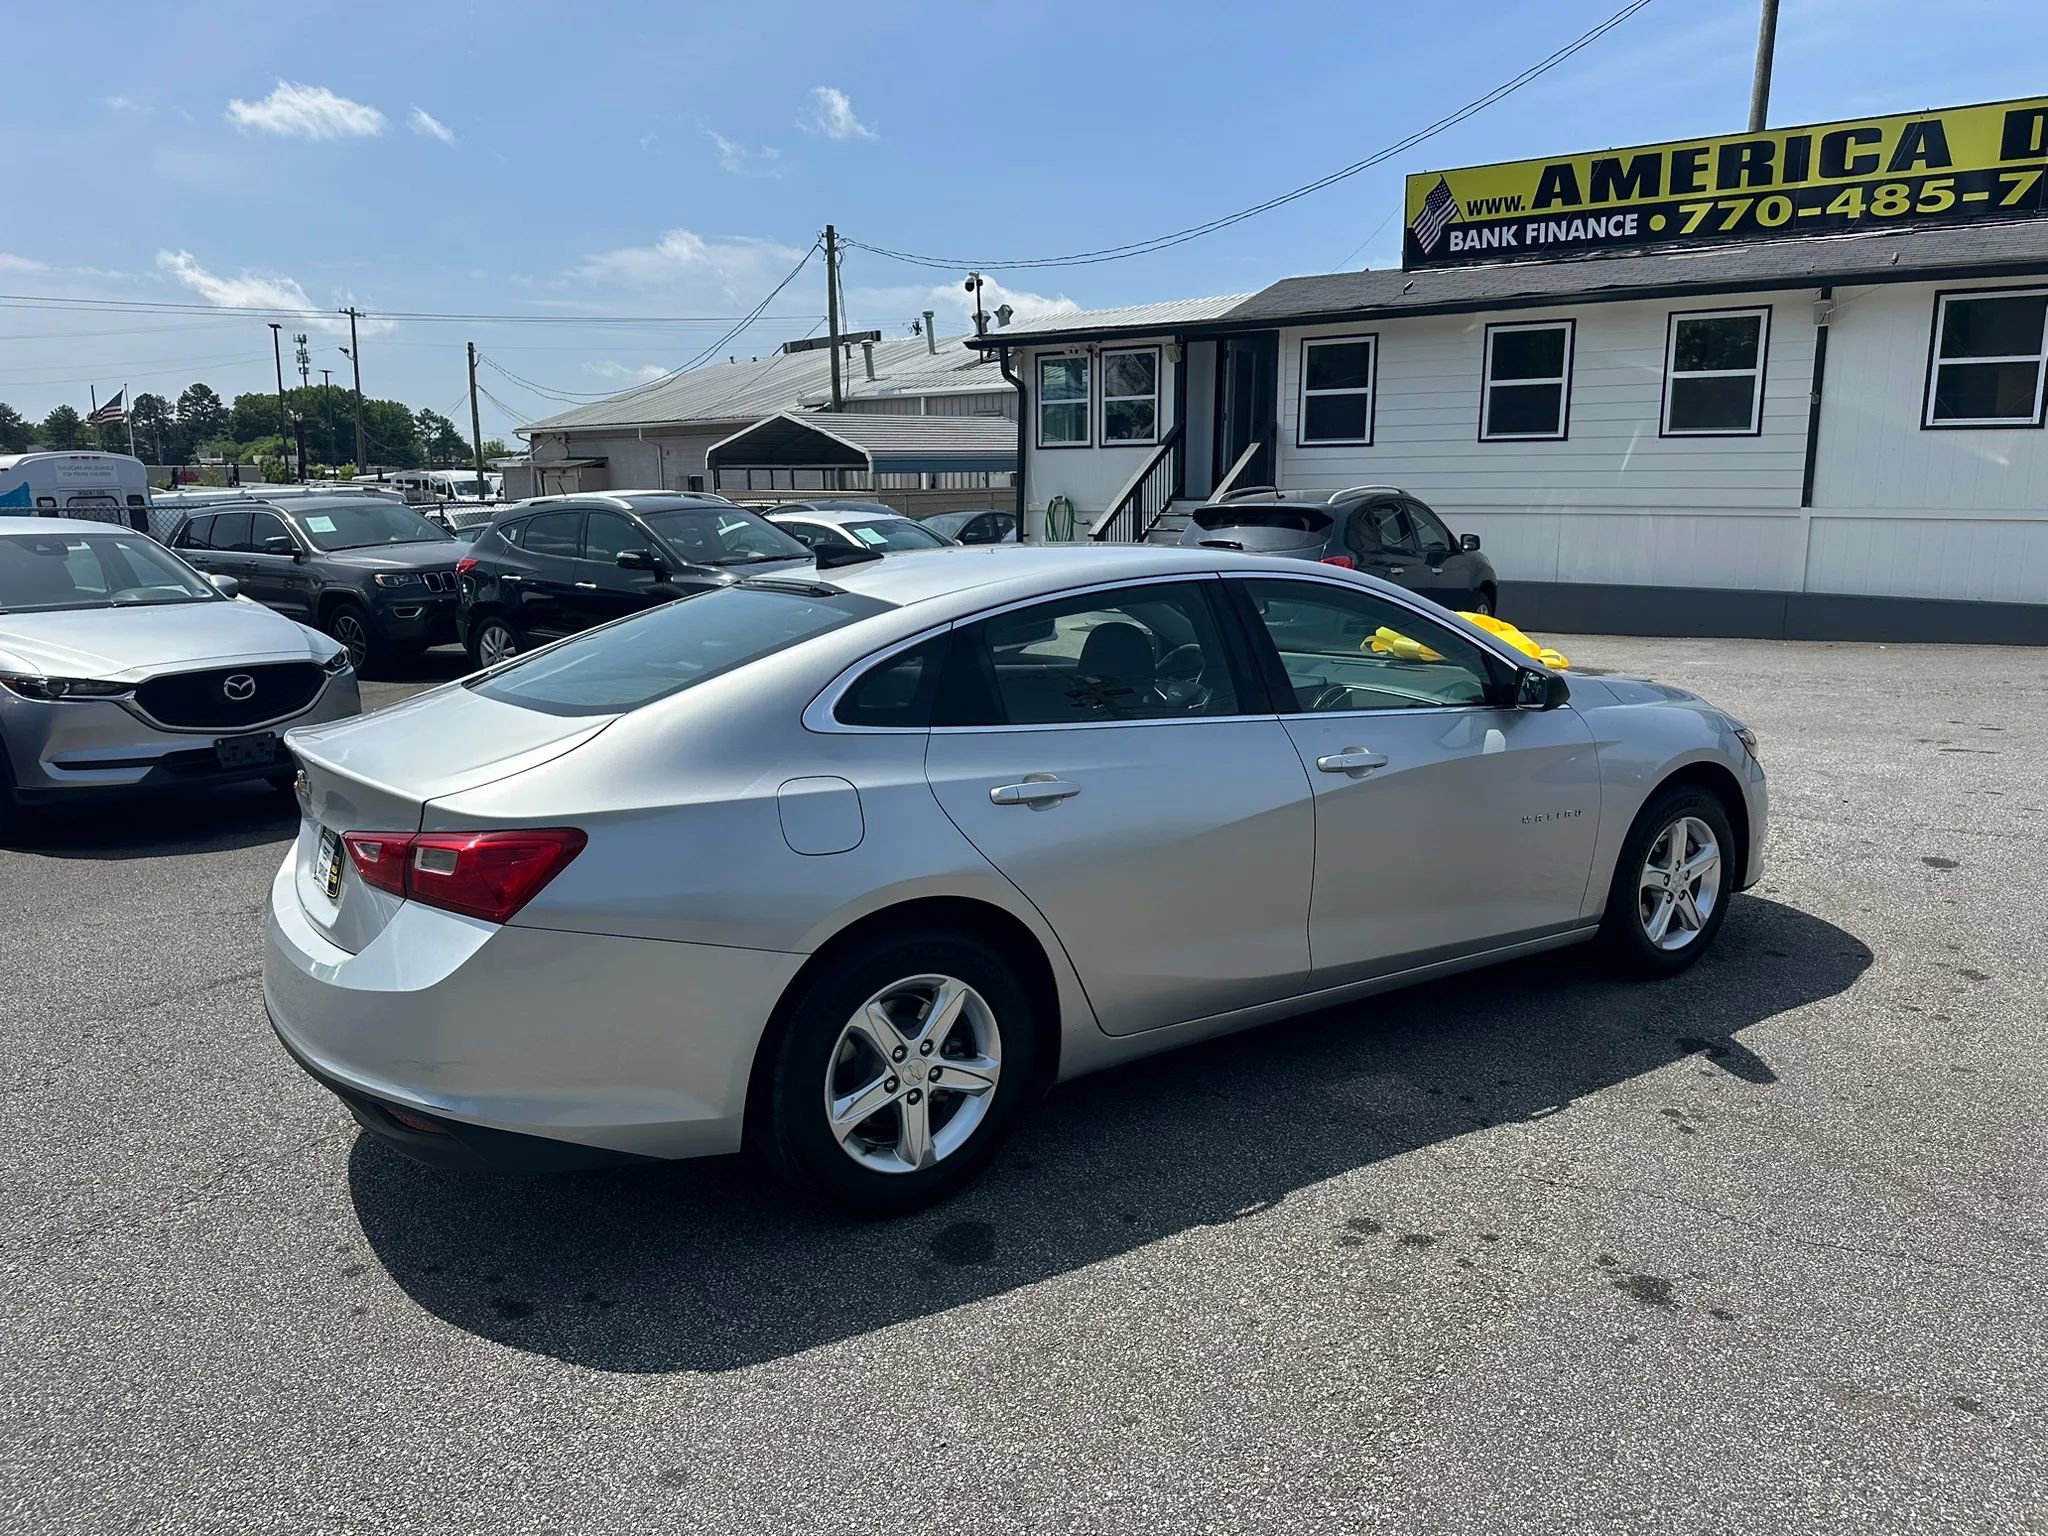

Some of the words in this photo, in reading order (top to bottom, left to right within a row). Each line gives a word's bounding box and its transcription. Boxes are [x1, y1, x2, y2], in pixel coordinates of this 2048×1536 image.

[1531, 119, 1953, 210] AMERICA
[1450, 225, 1518, 251] BANK
[1525, 213, 1638, 245] FINANCE
